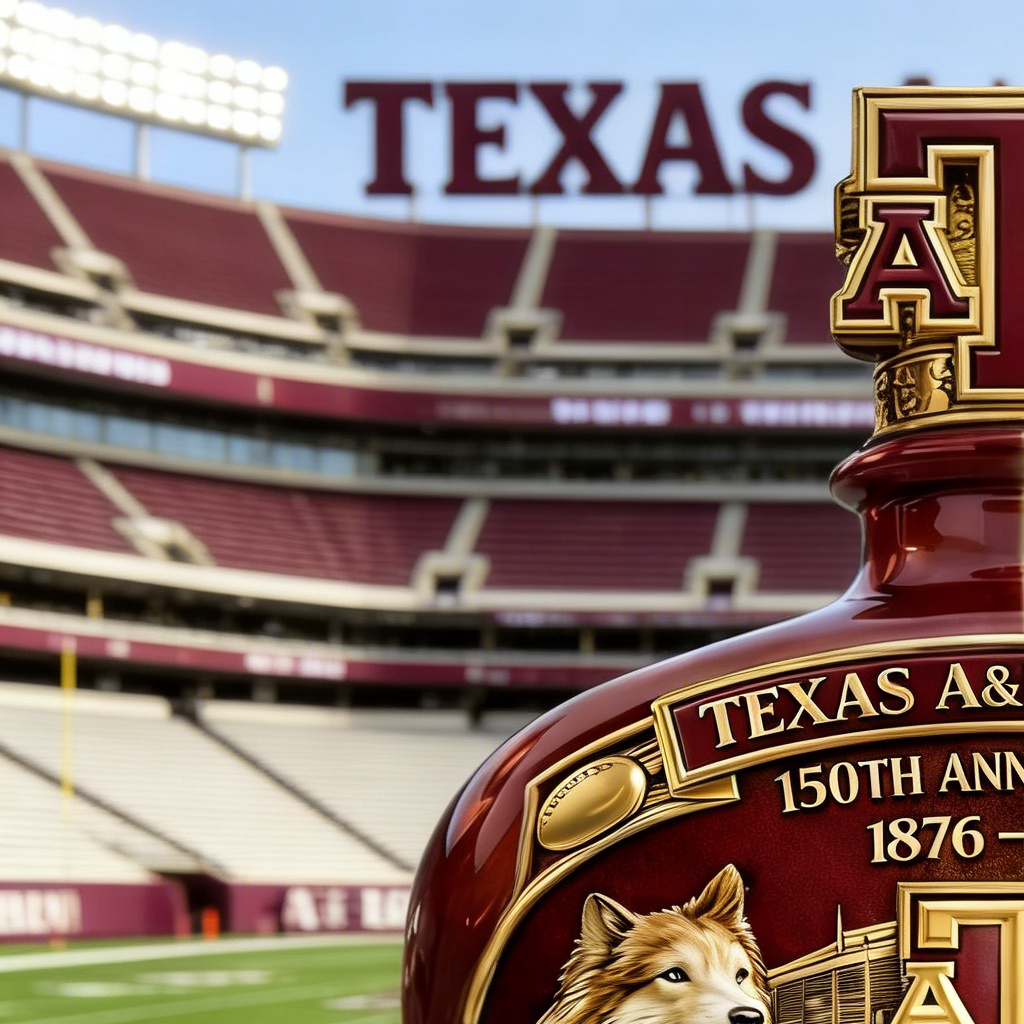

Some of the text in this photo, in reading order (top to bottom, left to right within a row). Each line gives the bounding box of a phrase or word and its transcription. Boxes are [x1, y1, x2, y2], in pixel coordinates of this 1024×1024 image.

[343, 79, 818, 197] TEXAS
[699, 667, 913, 750] TEXAS
[773, 756, 925, 814] 150TH
[867, 815, 986, 865] 1876
